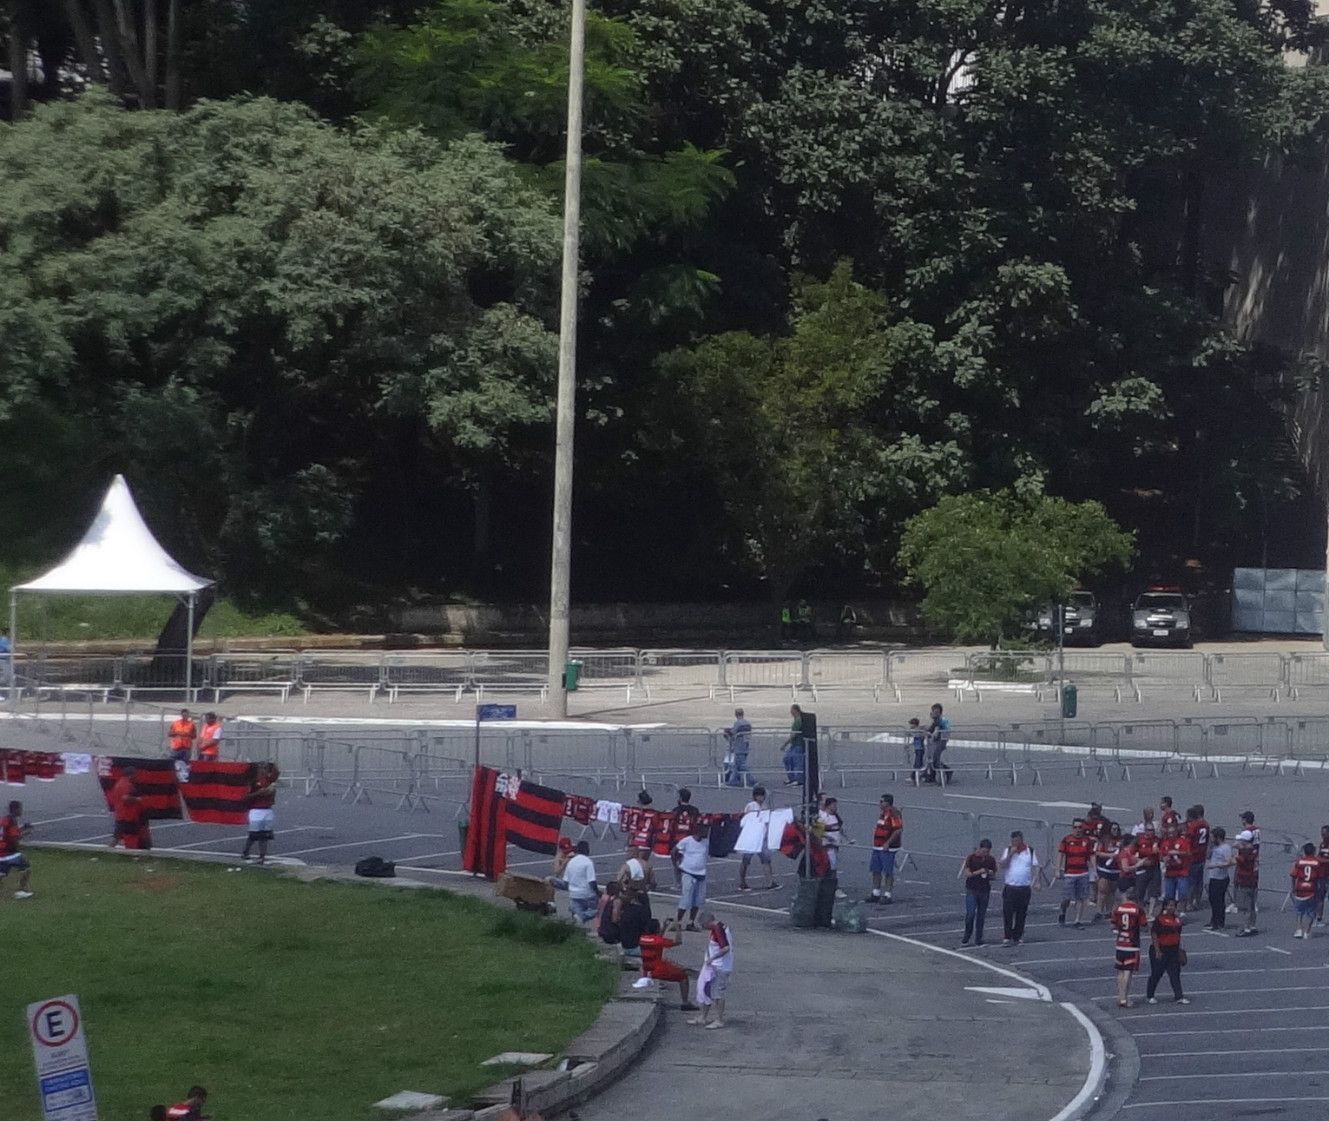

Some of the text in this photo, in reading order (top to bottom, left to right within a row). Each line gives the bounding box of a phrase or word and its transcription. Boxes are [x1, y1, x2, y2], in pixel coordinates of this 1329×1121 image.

[1199, 828, 1207, 844] 2
[1304, 865, 1311, 881] 9
[1121, 913, 1130, 930] 9
[45, 1010, 65, 1038] E
